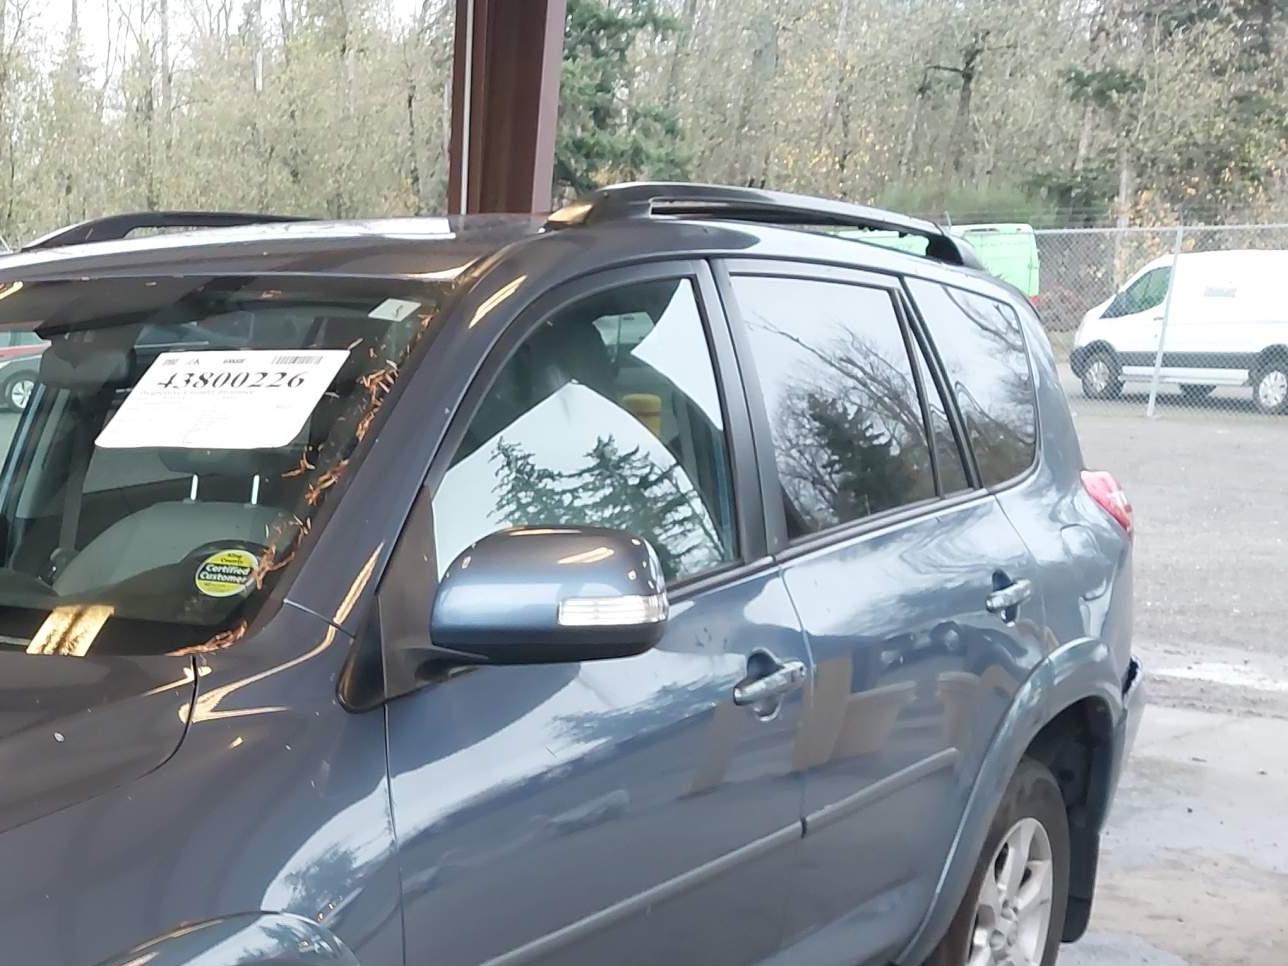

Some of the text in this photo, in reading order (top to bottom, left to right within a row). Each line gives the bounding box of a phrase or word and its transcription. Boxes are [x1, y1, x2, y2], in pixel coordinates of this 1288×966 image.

[157, 371, 309, 390] 43800226
[205, 564, 251, 575] Certified
[199, 571, 248, 583] Customer
